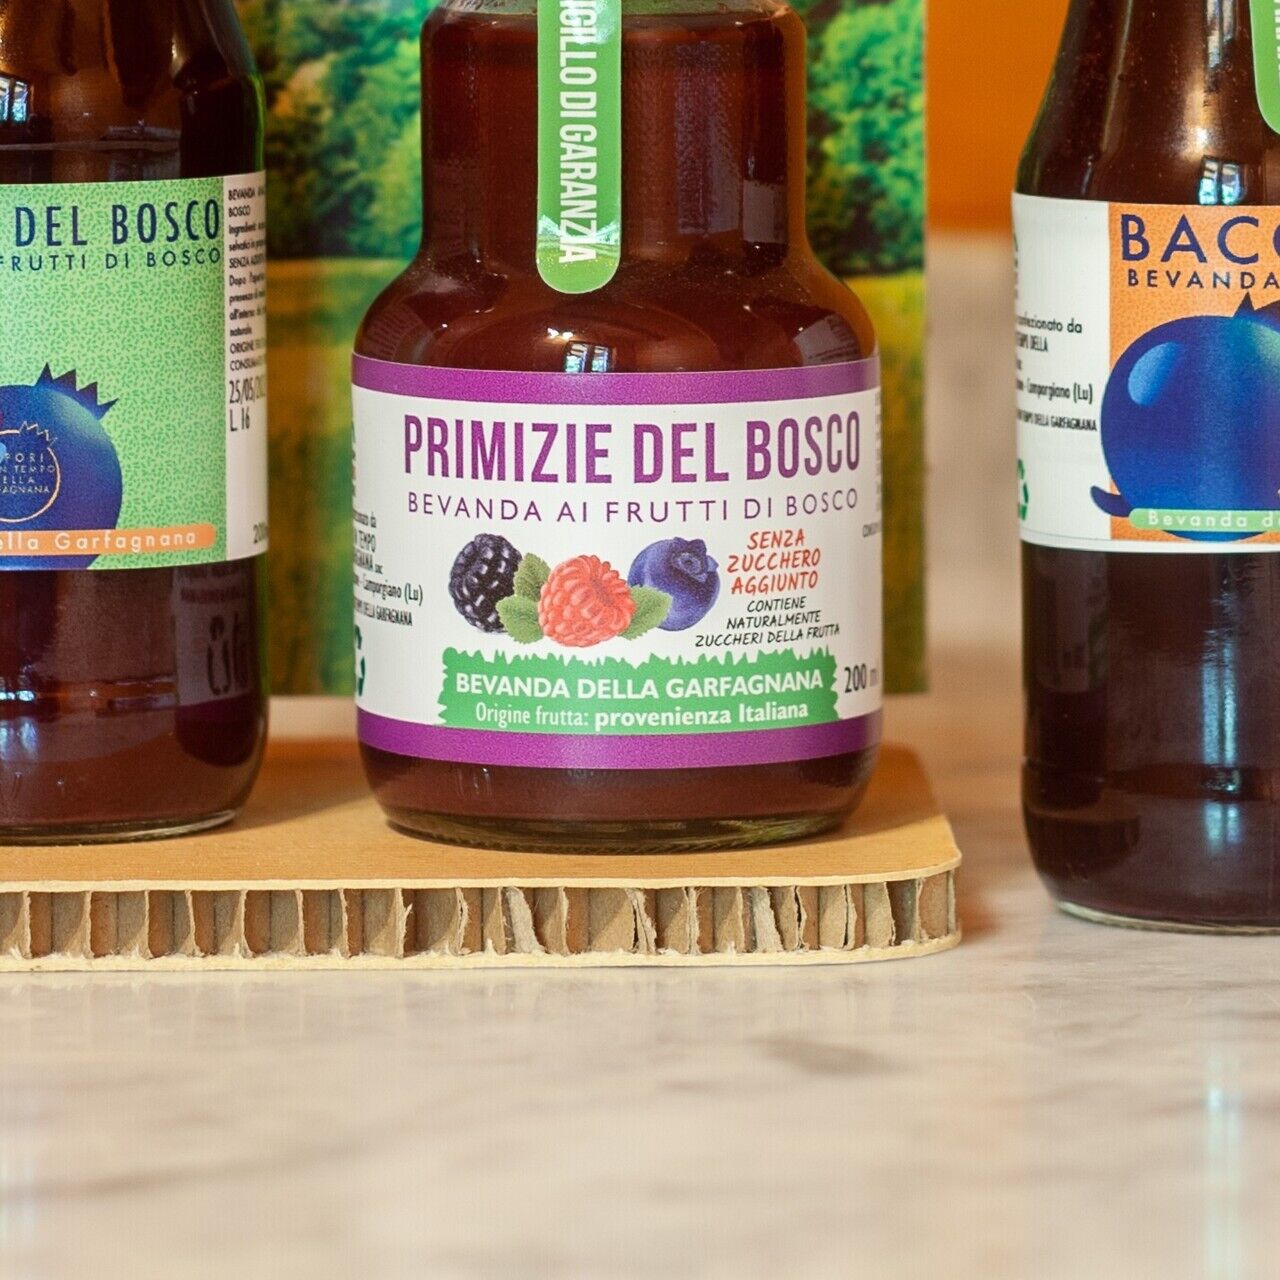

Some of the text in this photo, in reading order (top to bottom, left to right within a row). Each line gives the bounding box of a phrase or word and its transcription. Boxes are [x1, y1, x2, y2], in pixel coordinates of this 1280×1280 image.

[560, 92, 597, 117] DI
[559, 124, 597, 264] GARANZIA
[16, 205, 87, 247] DEL
[111, 199, 220, 245] BOSCO
[106, 253, 129, 269] DI
[147, 248, 221, 267] BOSCO
[1128, 268, 1280, 290] BEVANDA
[1067, 317, 1083, 334] da
[1073, 382, 1093, 405] (Lu)
[404, 415, 612, 484] PRIMIZIE
[633, 421, 730, 484] DEL
[746, 410, 861, 481] BOSCO
[408, 488, 857, 523] BEVANDA AI FRUTTI DI BOSCO
[1148, 510, 1248, 528] Bevanda
[55, 530, 196, 552] Garfagnana
[747, 528, 805, 550] SENZA
[727, 548, 821, 573] ZUCCHERO
[404, 582, 423, 607] (Lu)
[731, 570, 819, 595] AGGIUNTO
[747, 596, 807, 613] CONTIENE
[726, 610, 821, 630] NATURALMENTE
[695, 623, 840, 647] ZUCCHERI DELLA FRUTTA
[456, 669, 823, 700] BEVANDA DELLA GARFAGNANA
[844, 663, 867, 694] 200
[475, 703, 809, 732] Origine frutta: provenienza Italiana
